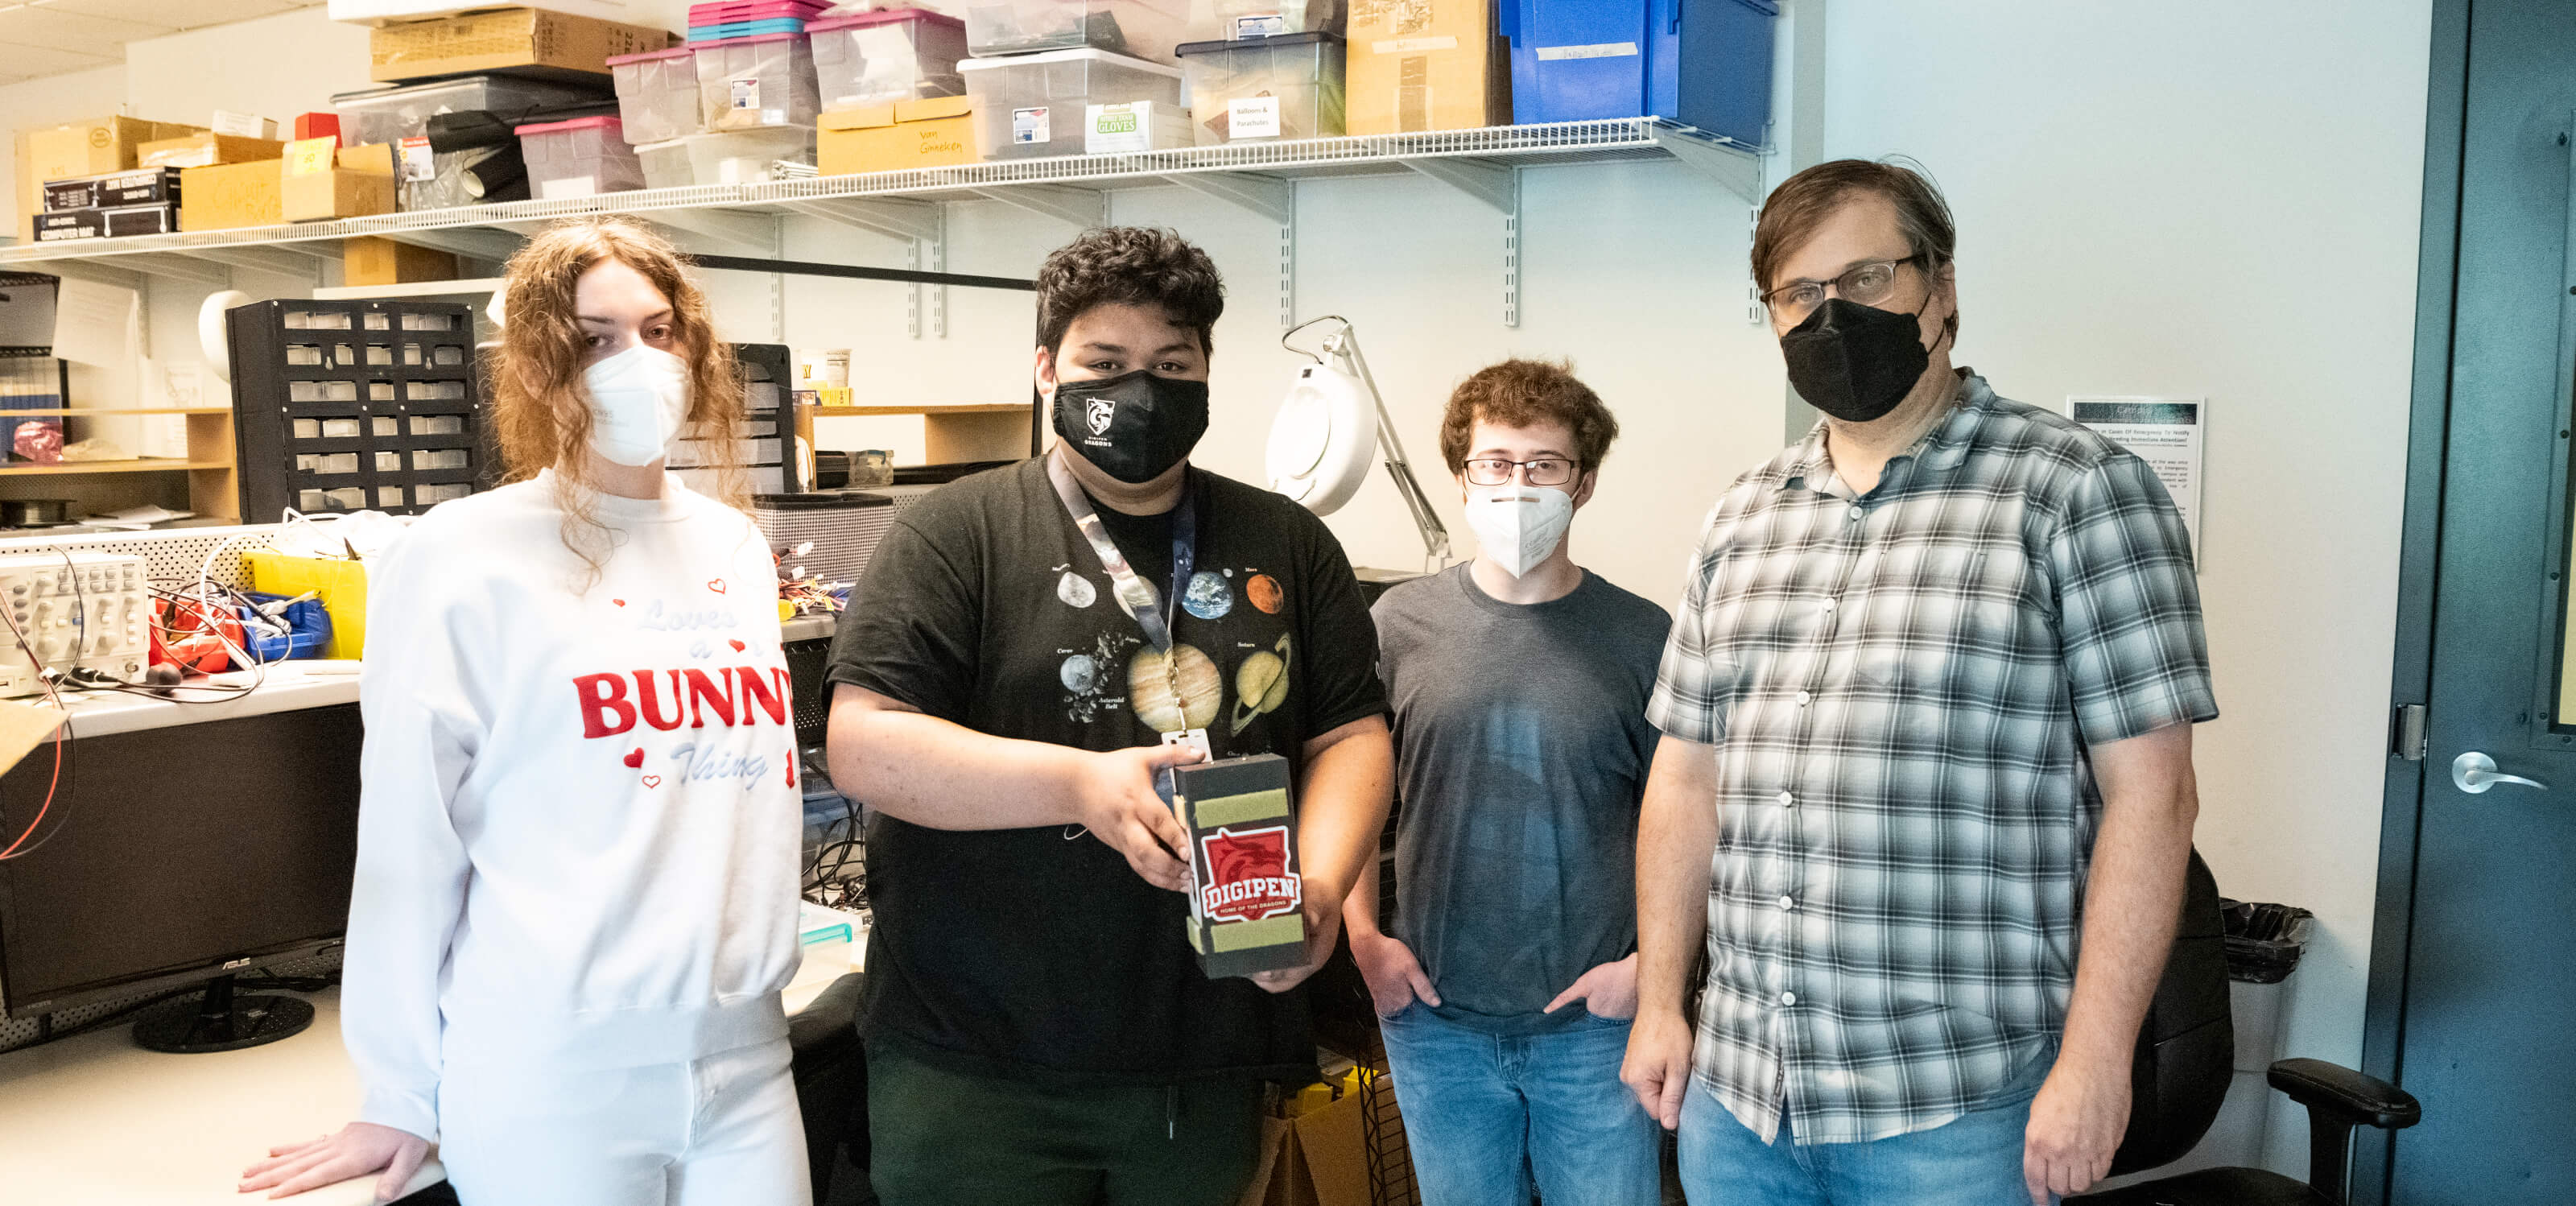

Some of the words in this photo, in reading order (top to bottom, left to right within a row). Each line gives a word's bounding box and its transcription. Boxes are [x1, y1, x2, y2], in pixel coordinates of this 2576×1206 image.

[1236, 107, 1261, 115] Balloons
[1098, 121, 1135, 133] GLOVES
[40, 227, 79, 241] COMPUTER
[78, 226, 95, 238] MAT
[638, 599, 739, 632] Loves
[689, 641, 712, 659] a
[572, 666, 794, 739] BUNN
[1098, 696, 1125, 704] Asteroid
[670, 742, 768, 791] Thing
[1208, 877, 1295, 910] DIGIPEN
[1259, 900, 1286, 909] DRAGONS
[222, 956, 251, 971] ASUS
